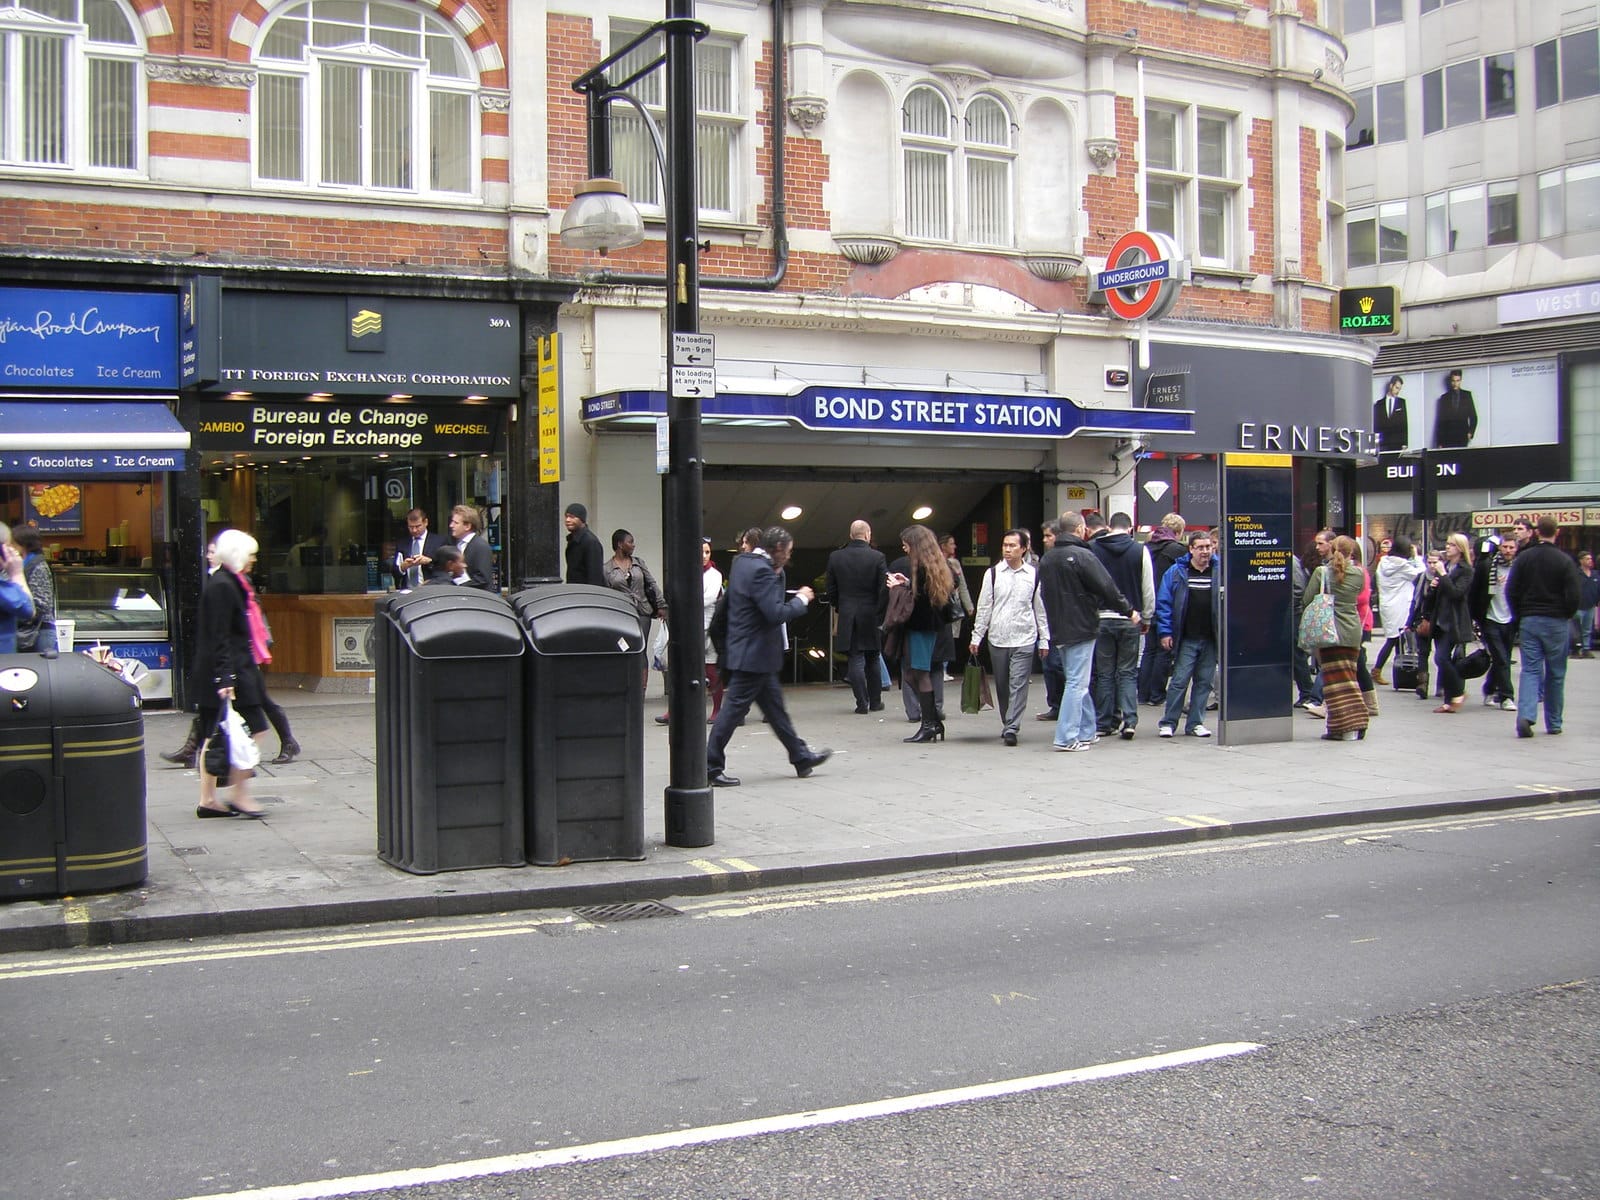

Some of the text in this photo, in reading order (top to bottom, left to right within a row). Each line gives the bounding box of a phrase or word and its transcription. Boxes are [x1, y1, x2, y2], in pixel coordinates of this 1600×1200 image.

[1102, 265, 1165, 285] UNDERGROUND
[1536, 289, 1582, 312] west
[81, 307, 160, 343] Company
[1342, 314, 1392, 328] ROLEX
[675, 335, 712, 345] No loading
[5, 365, 162, 378] Chocolates Ice Cream
[221, 369, 511, 386] TT FOREIGN EXCHANGE CORPORATION
[675, 369, 712, 379] No loading
[1152, 384, 1182, 395] ERNEST
[588, 399, 616, 413] BOND STREET
[815, 397, 1062, 427] BOND STREET STATION
[253, 408, 429, 427] Bureau de Change
[199, 422, 245, 433] CAMBIO
[434, 423, 489, 435] WECHSEL
[254, 429, 423, 449] Foreign Exchange
[1241, 422, 1365, 453] ERNEST
[29, 455, 175, 468] Chocolates Ice Cream
[1068, 490, 1084, 498] RVP
[1474, 513, 1514, 525] COLD
[1267, 573, 1280, 581] Arch
[114, 647, 159, 657] CREAM
